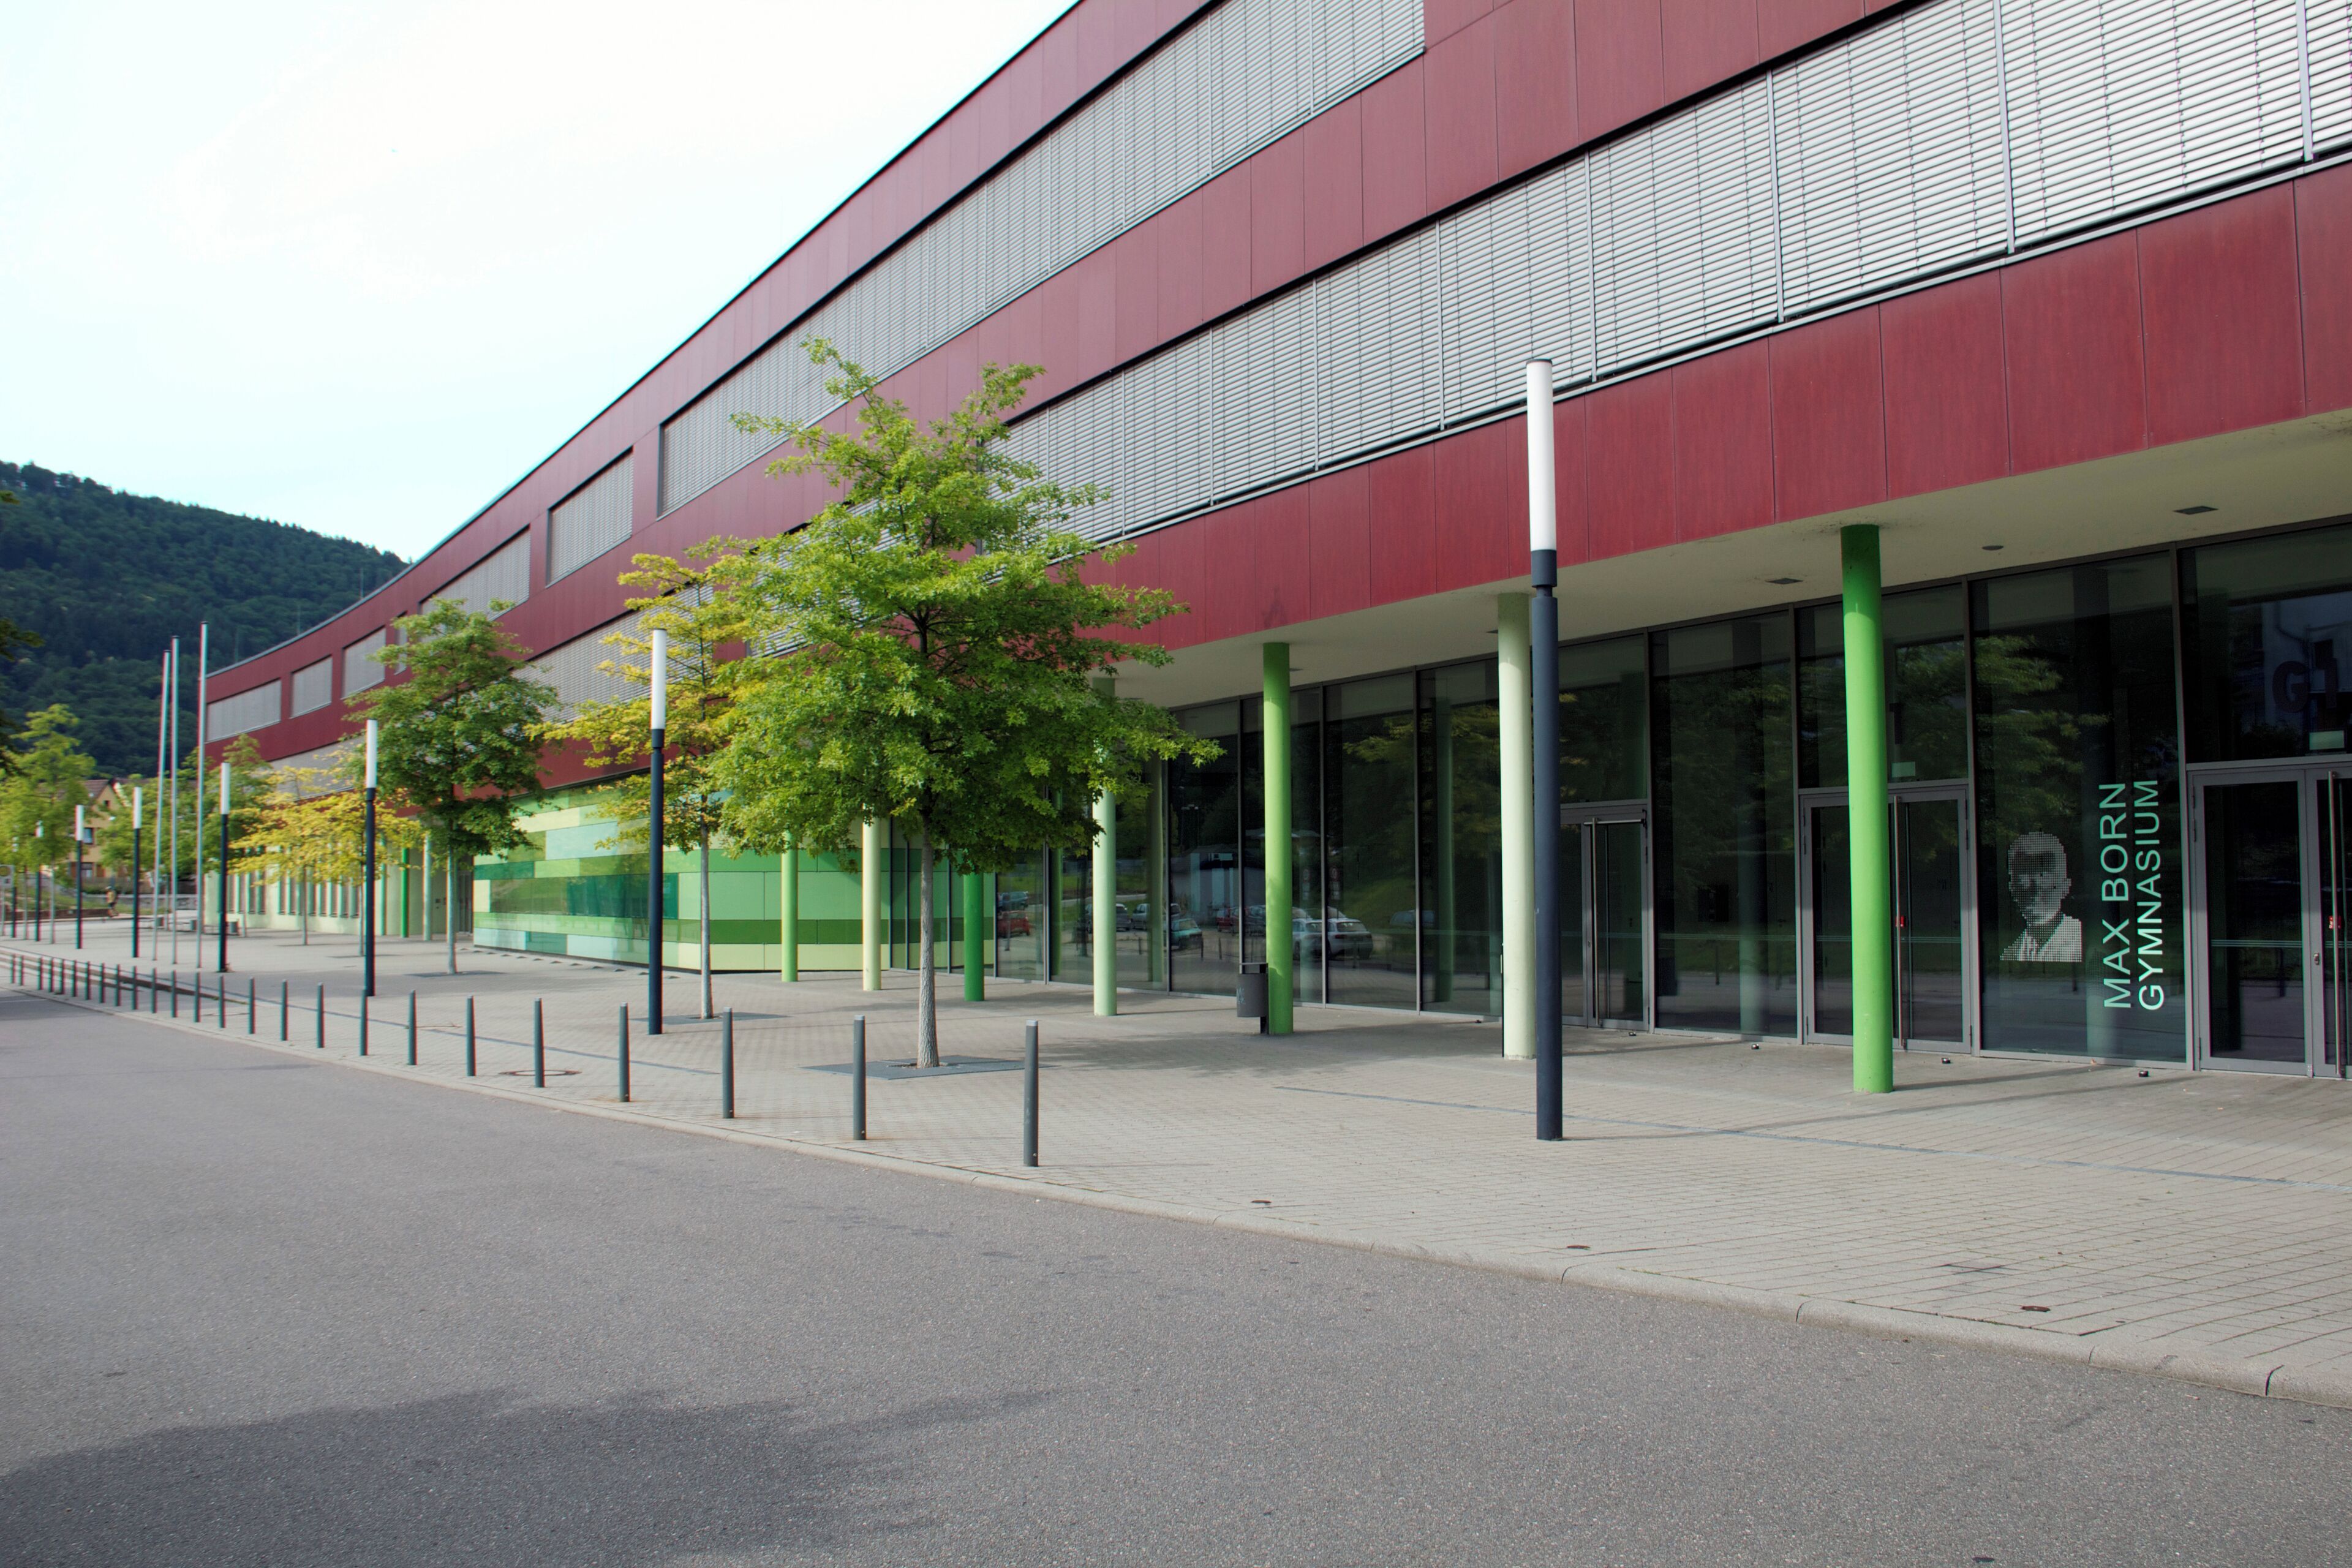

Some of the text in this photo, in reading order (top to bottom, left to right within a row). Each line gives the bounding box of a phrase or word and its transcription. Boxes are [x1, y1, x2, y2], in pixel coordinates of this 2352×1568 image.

[2098, 783, 2131, 1008] MAX BORN
[2133, 780, 2164, 1010] GYMNASIUM
